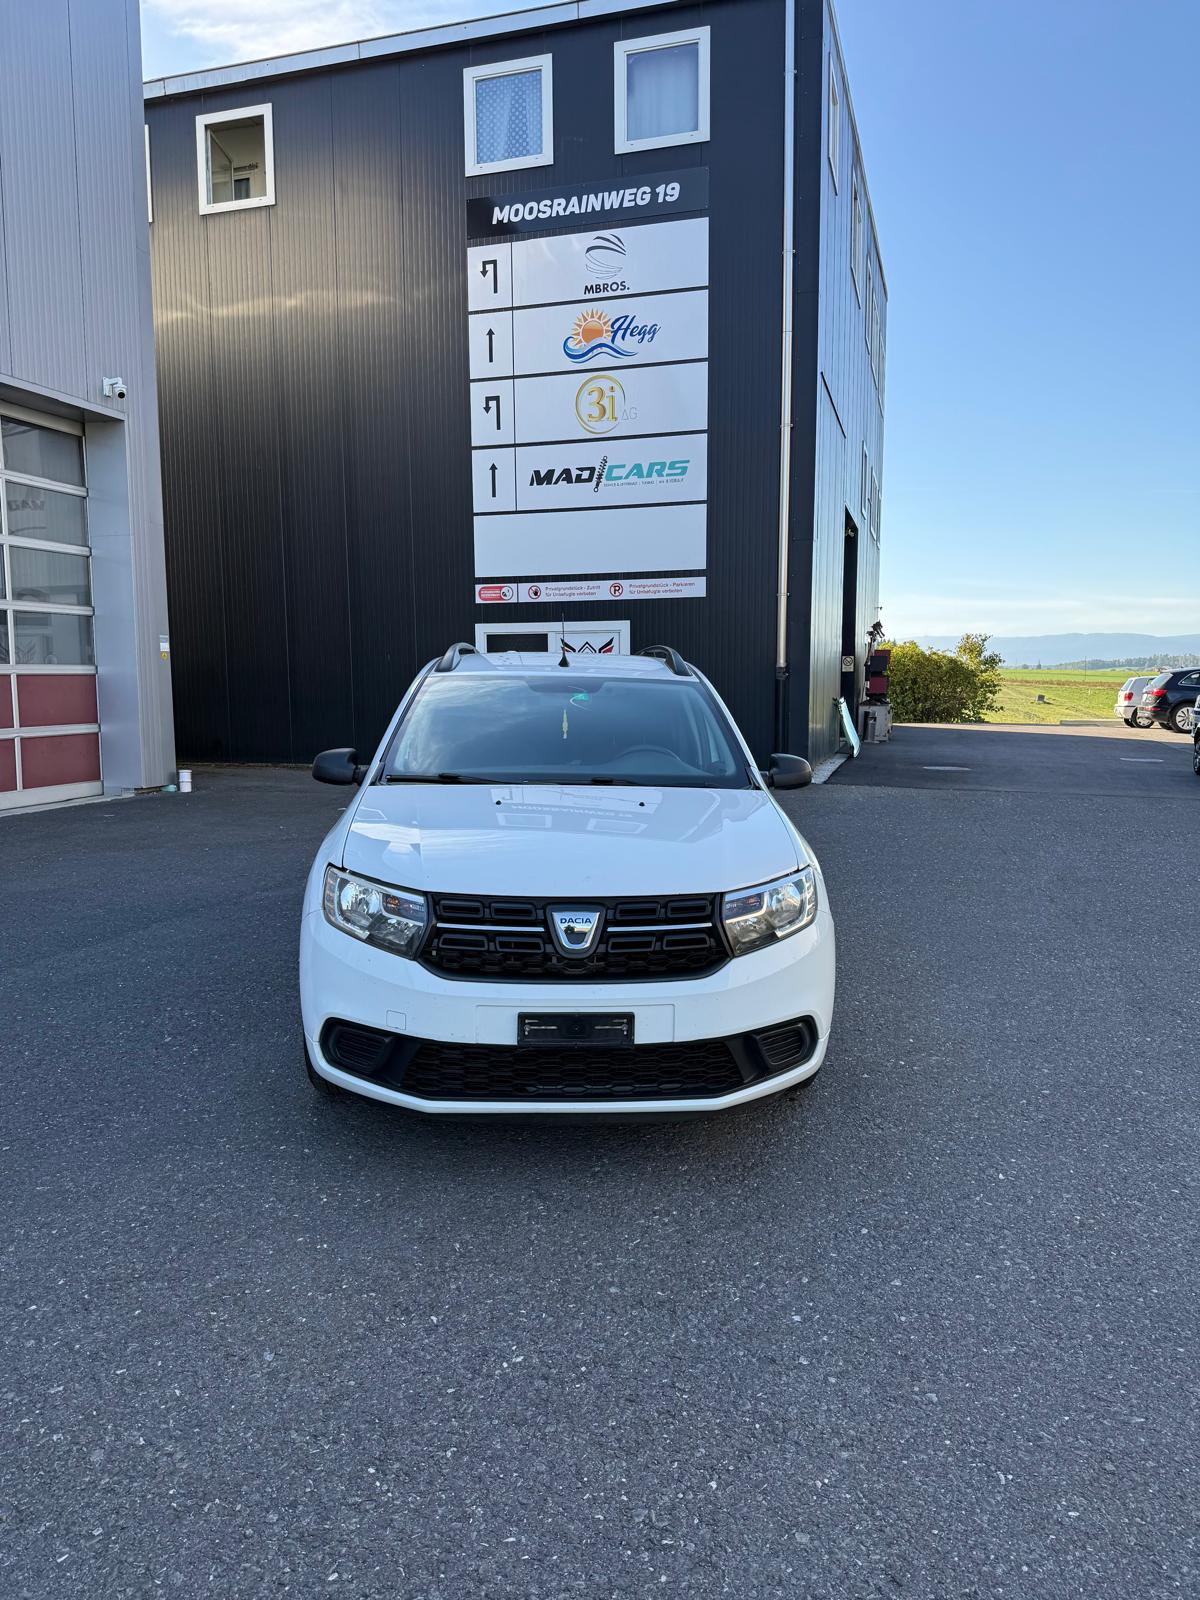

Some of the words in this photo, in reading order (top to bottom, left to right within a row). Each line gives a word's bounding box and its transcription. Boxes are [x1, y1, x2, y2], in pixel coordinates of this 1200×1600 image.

[492, 186, 651, 224] MOOSRAINWEG
[655, 182, 680, 203] 19
[584, 281, 630, 295] MBROS.
[610, 315, 661, 344] Hegg
[587, 386, 618, 422] 3i
[529, 466, 596, 486] MAD
[605, 459, 690, 481] CARS
